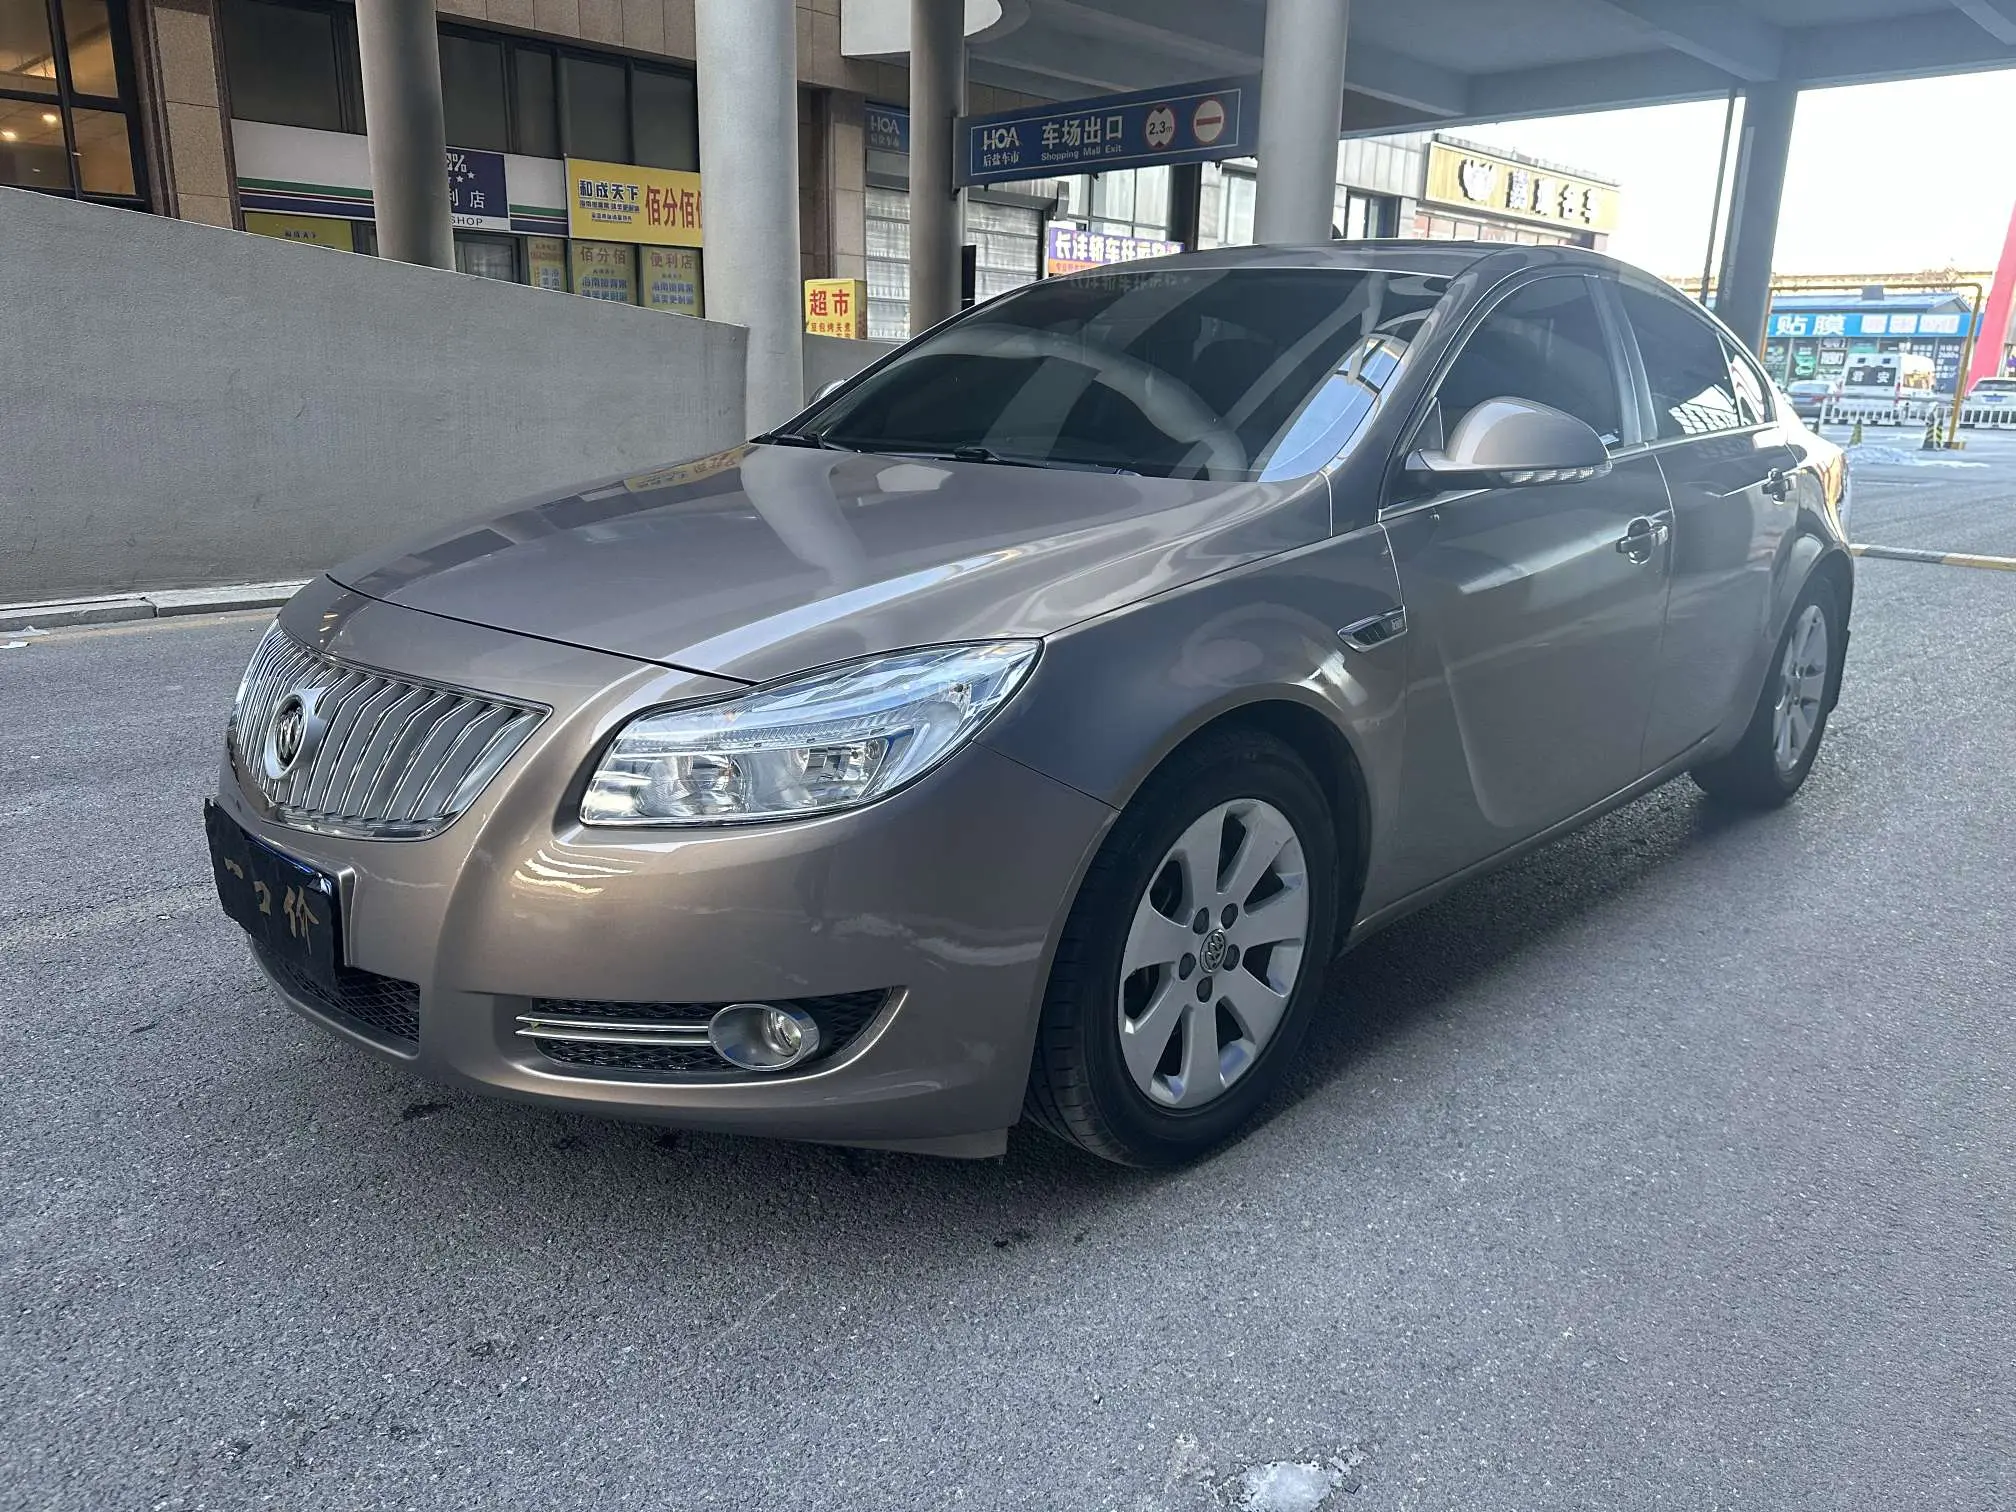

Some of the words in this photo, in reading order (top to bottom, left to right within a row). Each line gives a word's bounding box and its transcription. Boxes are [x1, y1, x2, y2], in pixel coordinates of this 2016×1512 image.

[983, 127, 1022, 151] HOA
[1041, 115, 1124, 150] 车场出口
[1149, 121, 1173, 136] 2.3m
[1041, 150, 1079, 161] Shopping
[1083, 146, 1101, 156] Mall
[1105, 145, 1122, 154] Exit
[578, 179, 640, 201] 和成天下
[645, 184, 702, 229] 佰分佰
[451, 215, 483, 226] SHOP
[580, 245, 627, 265] 佰分佰
[650, 251, 694, 270] 便利店
[809, 289, 850, 317] 超市
[1775, 314, 1846, 337] 贴膜
